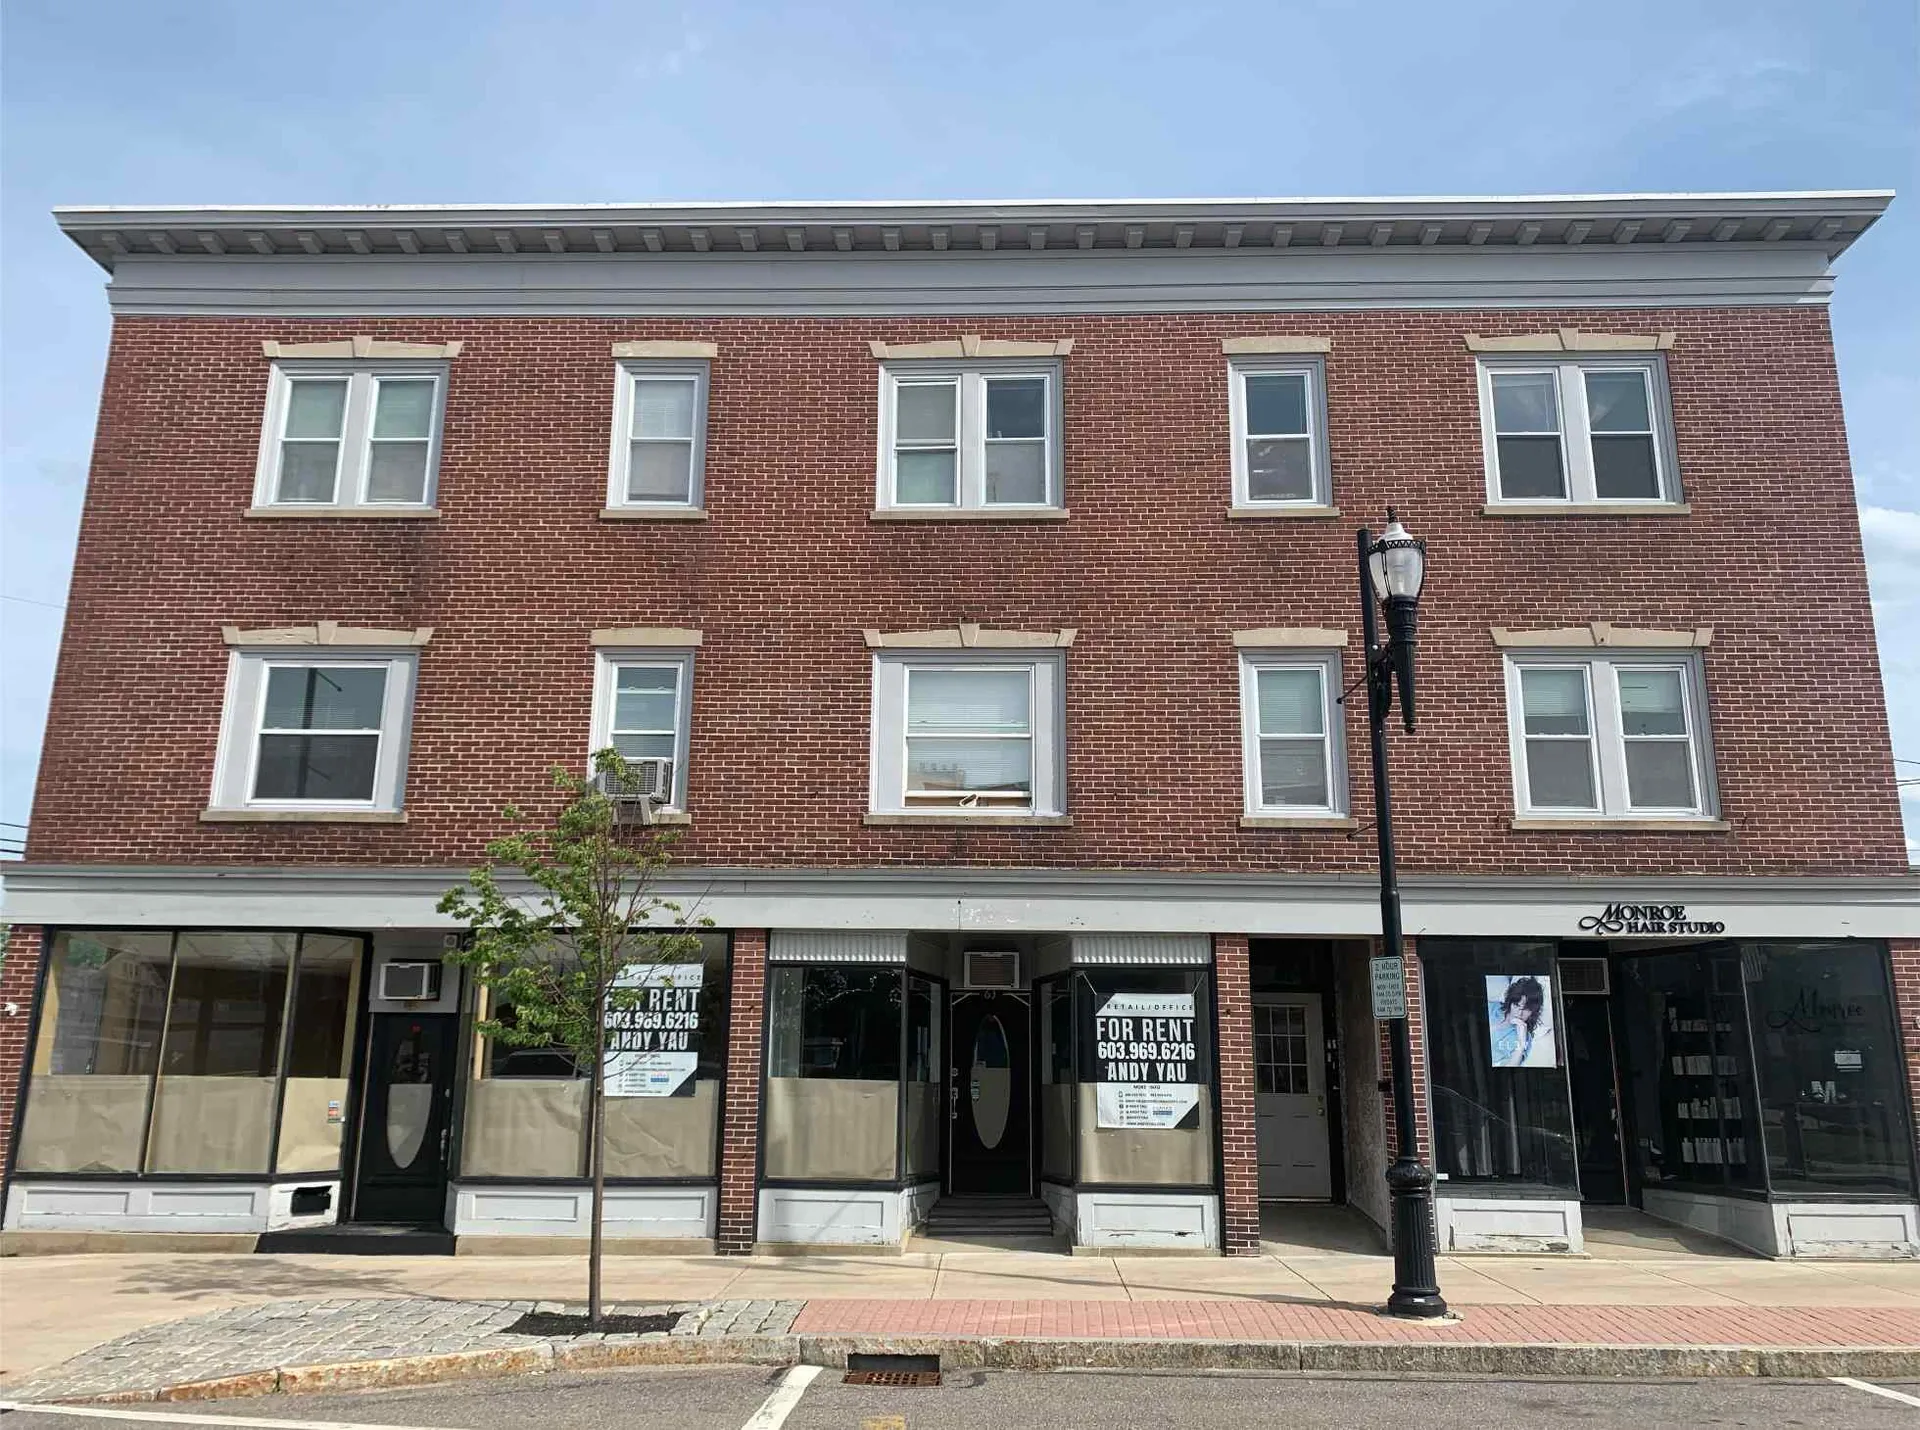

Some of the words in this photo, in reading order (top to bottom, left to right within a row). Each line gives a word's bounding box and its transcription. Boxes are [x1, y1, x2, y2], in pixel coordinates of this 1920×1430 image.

[1626, 921, 1667, 934] HAIR
[1668, 921, 1725, 934] STUDIO
[1381, 961, 1399, 971] HOUR
[649, 988, 701, 1012] RENT
[1106, 1003, 1193, 1011] RETAIL/OFFICE
[604, 1011, 699, 1030] 603.969.6216
[1096, 1018, 1134, 1041] FOR
[1142, 1018, 1194, 1041] RENT
[610, 1032, 652, 1051] ANDY
[658, 1031, 689, 1051] YAU
[1097, 1041, 1196, 1060] 603.969.6216
[1107, 1062, 1149, 1082] ANDY
[1156, 1062, 1187, 1082] YAU
